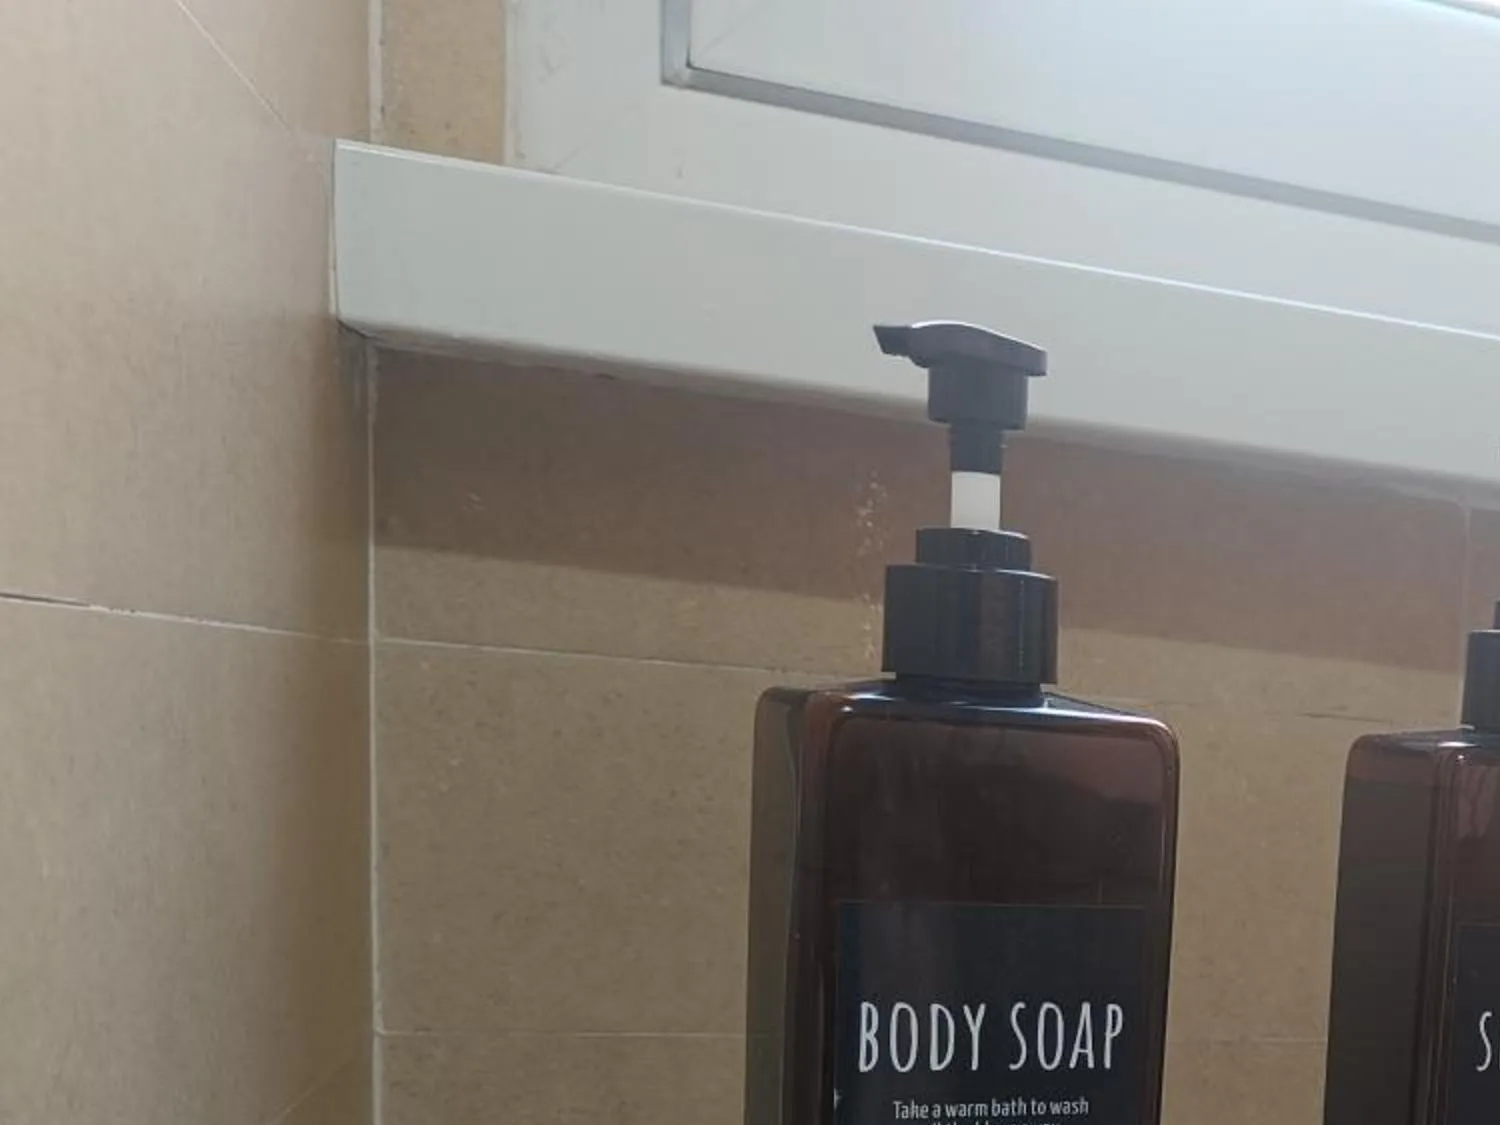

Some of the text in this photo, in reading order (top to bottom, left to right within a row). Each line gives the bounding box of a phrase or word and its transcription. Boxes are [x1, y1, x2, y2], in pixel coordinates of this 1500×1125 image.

[858, 1001, 1123, 1073] BODY SOAP
[893, 1097, 1089, 1119] Take a warm bath to wash
